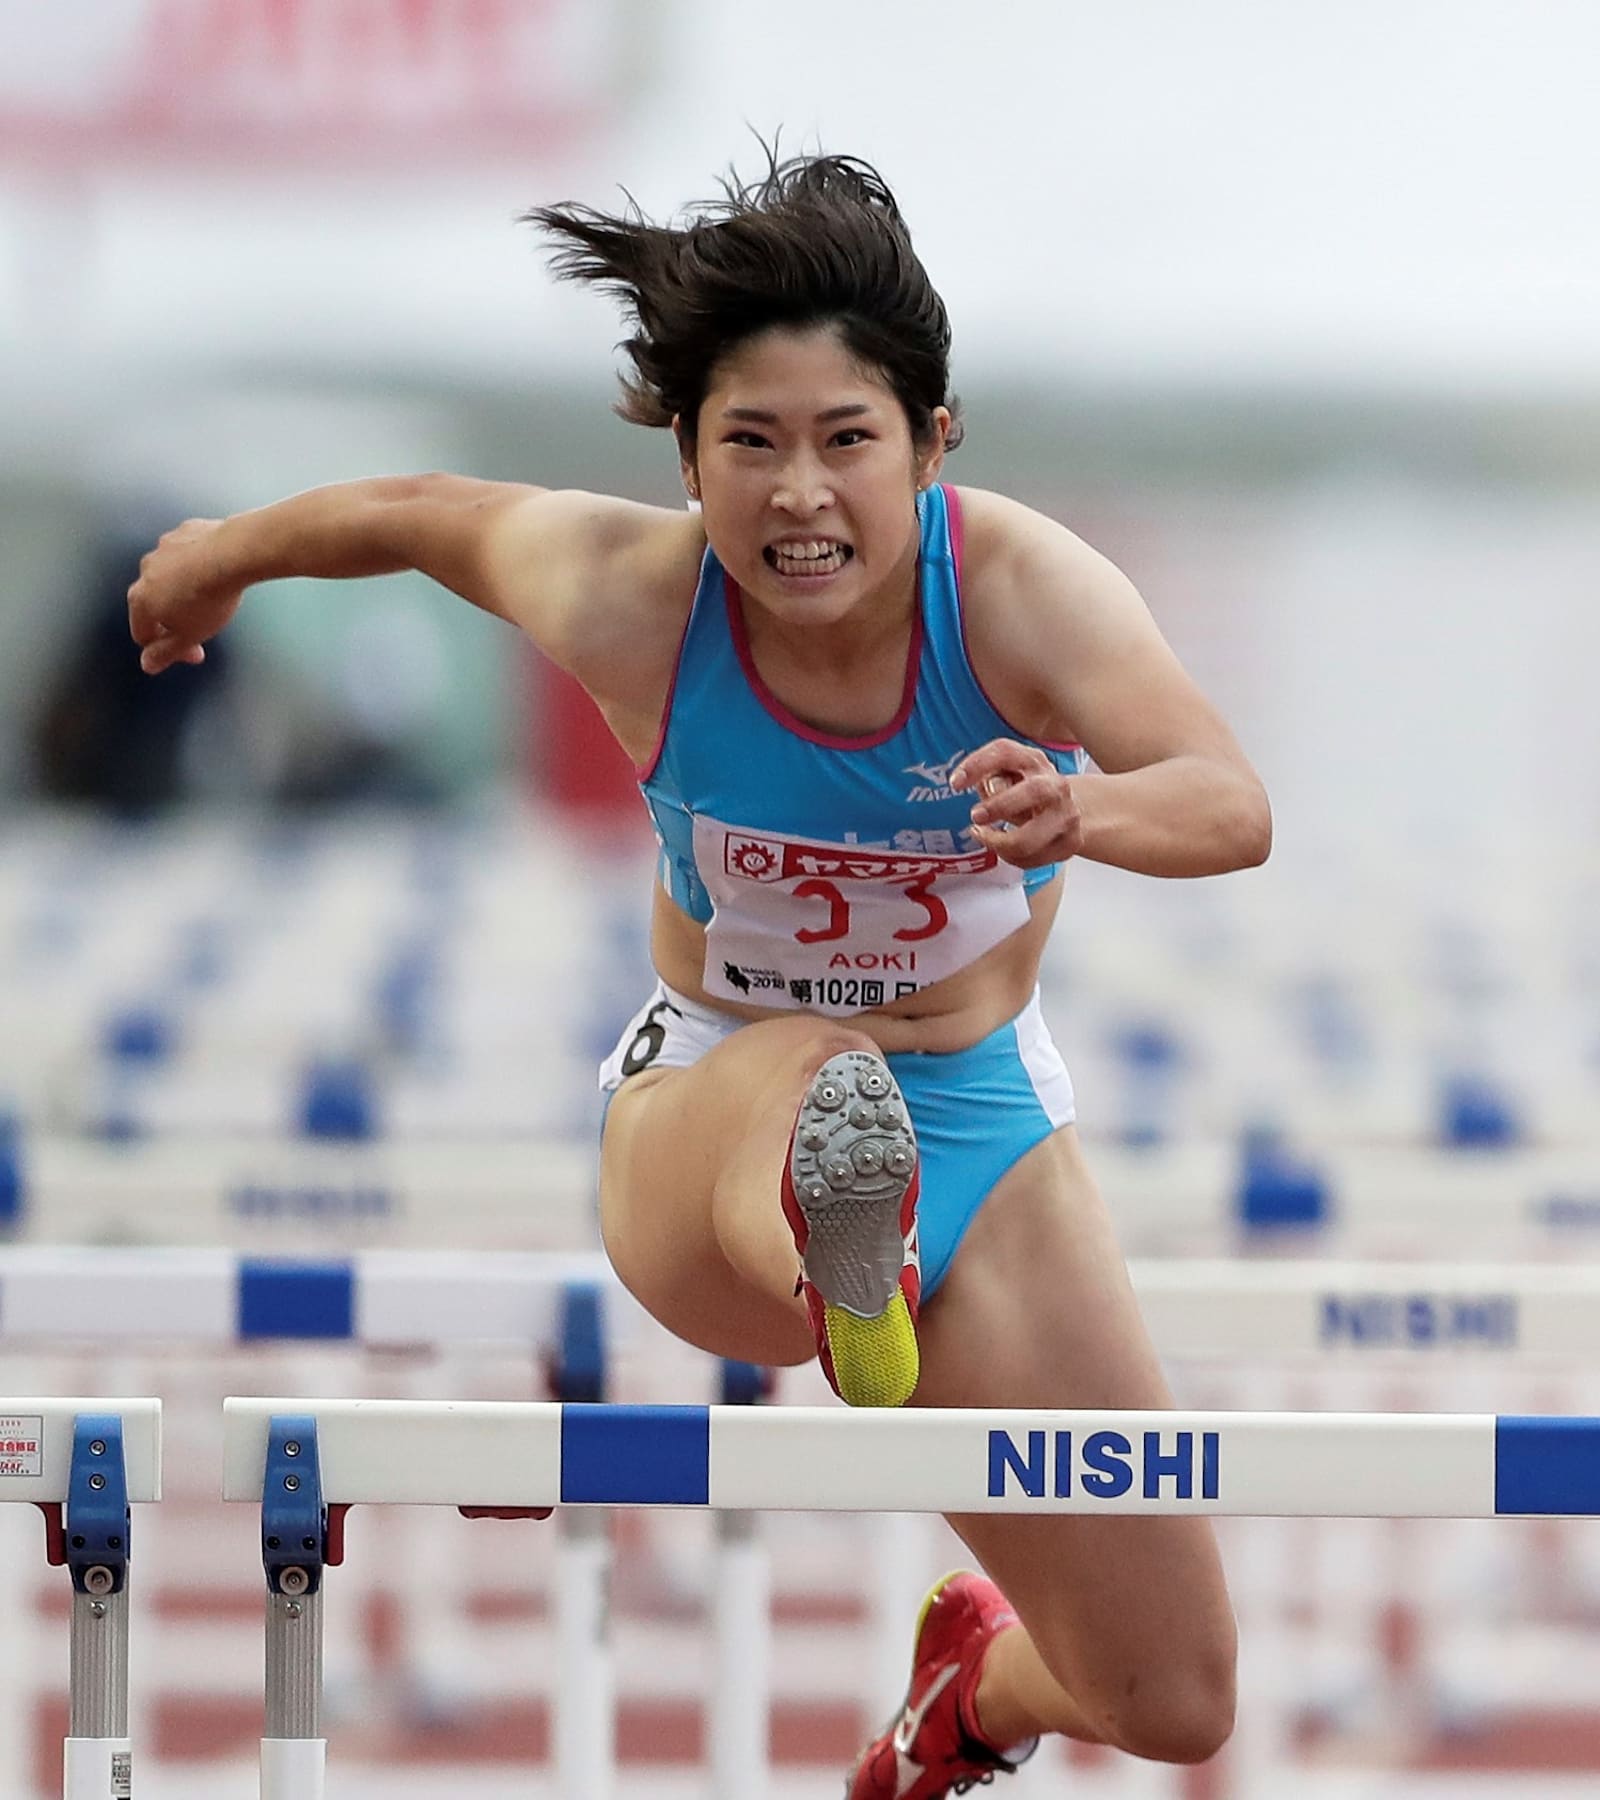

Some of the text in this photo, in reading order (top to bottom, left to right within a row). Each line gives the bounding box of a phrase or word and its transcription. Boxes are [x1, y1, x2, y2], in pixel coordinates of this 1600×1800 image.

[906, 785, 977, 802] MIZ
[828, 951, 916, 971] AOKI
[790, 978, 884, 1006] 第102回
[988, 1430, 1220, 1500] NISHI
